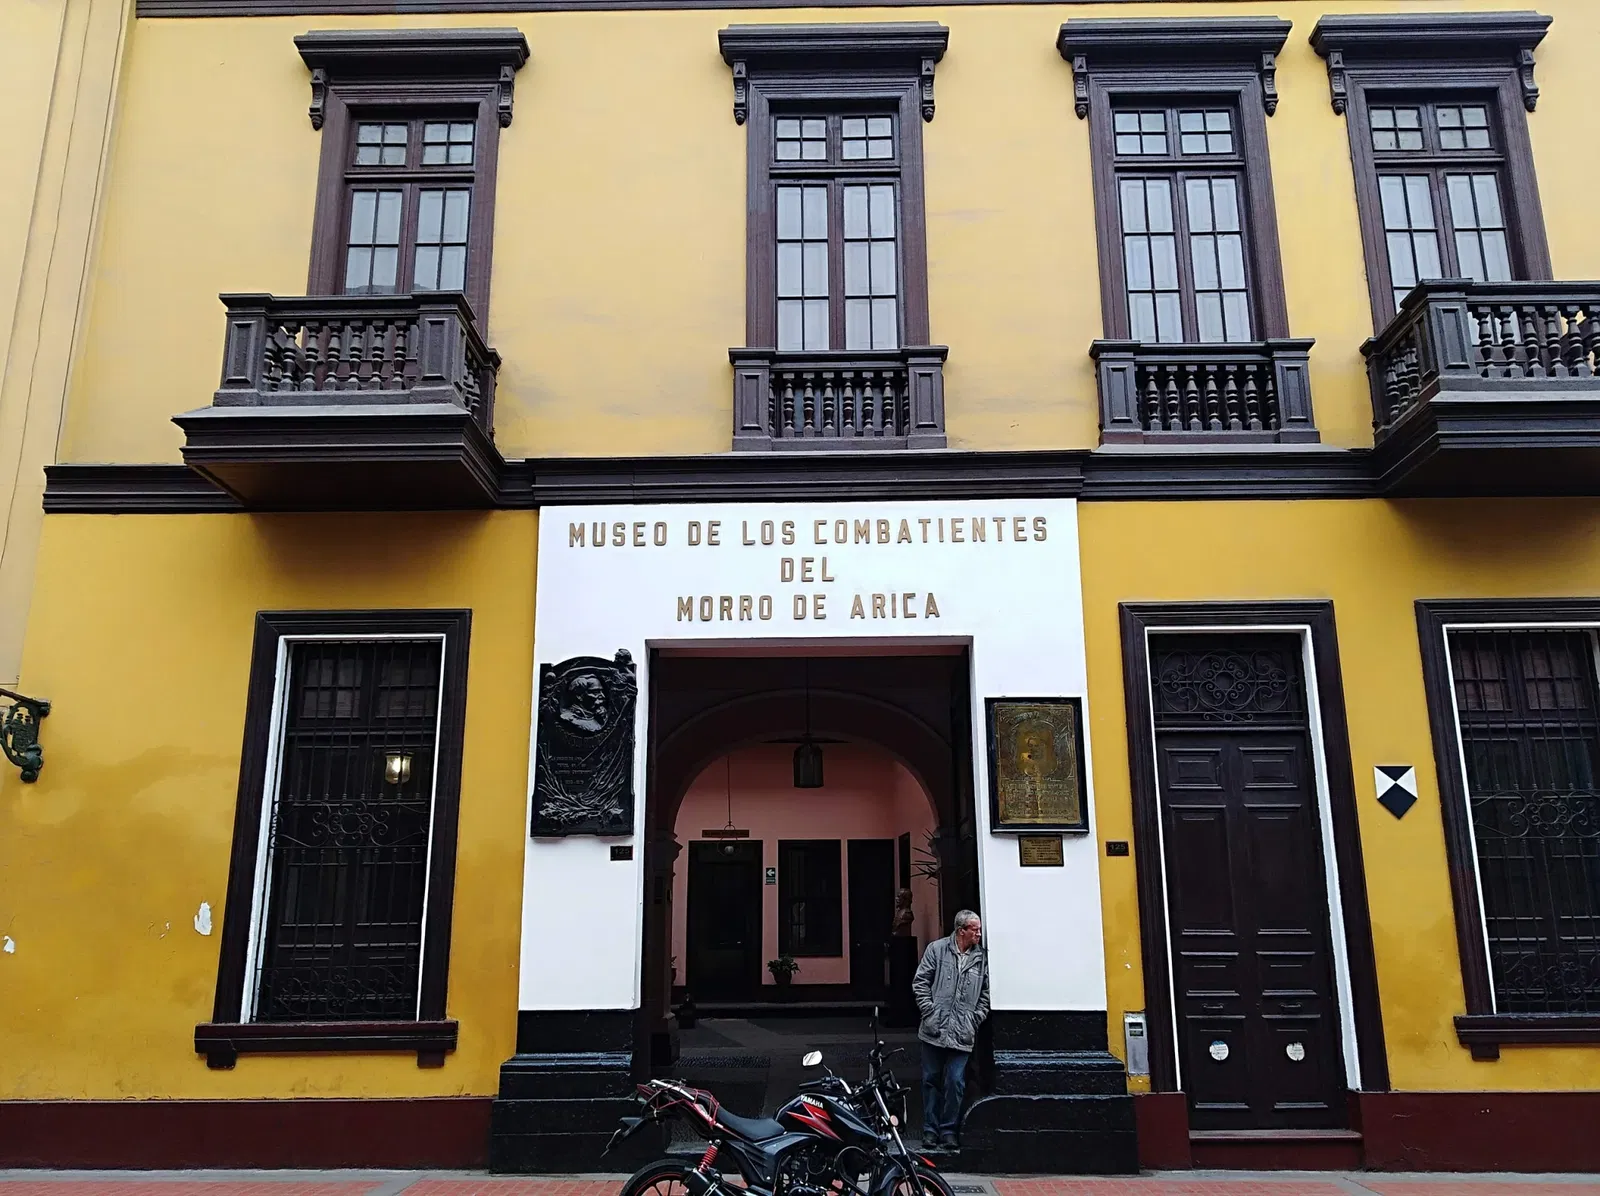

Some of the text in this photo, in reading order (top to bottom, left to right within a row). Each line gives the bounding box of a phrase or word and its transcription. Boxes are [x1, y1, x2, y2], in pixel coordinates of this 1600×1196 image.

[568, 516, 1048, 548] MUSEO DE LOS COMBATIENTES
[780, 556, 835, 583] DEL
[676, 592, 941, 623] MORRO DE ARICA
[800, 1094, 824, 1109] YAMAHA
